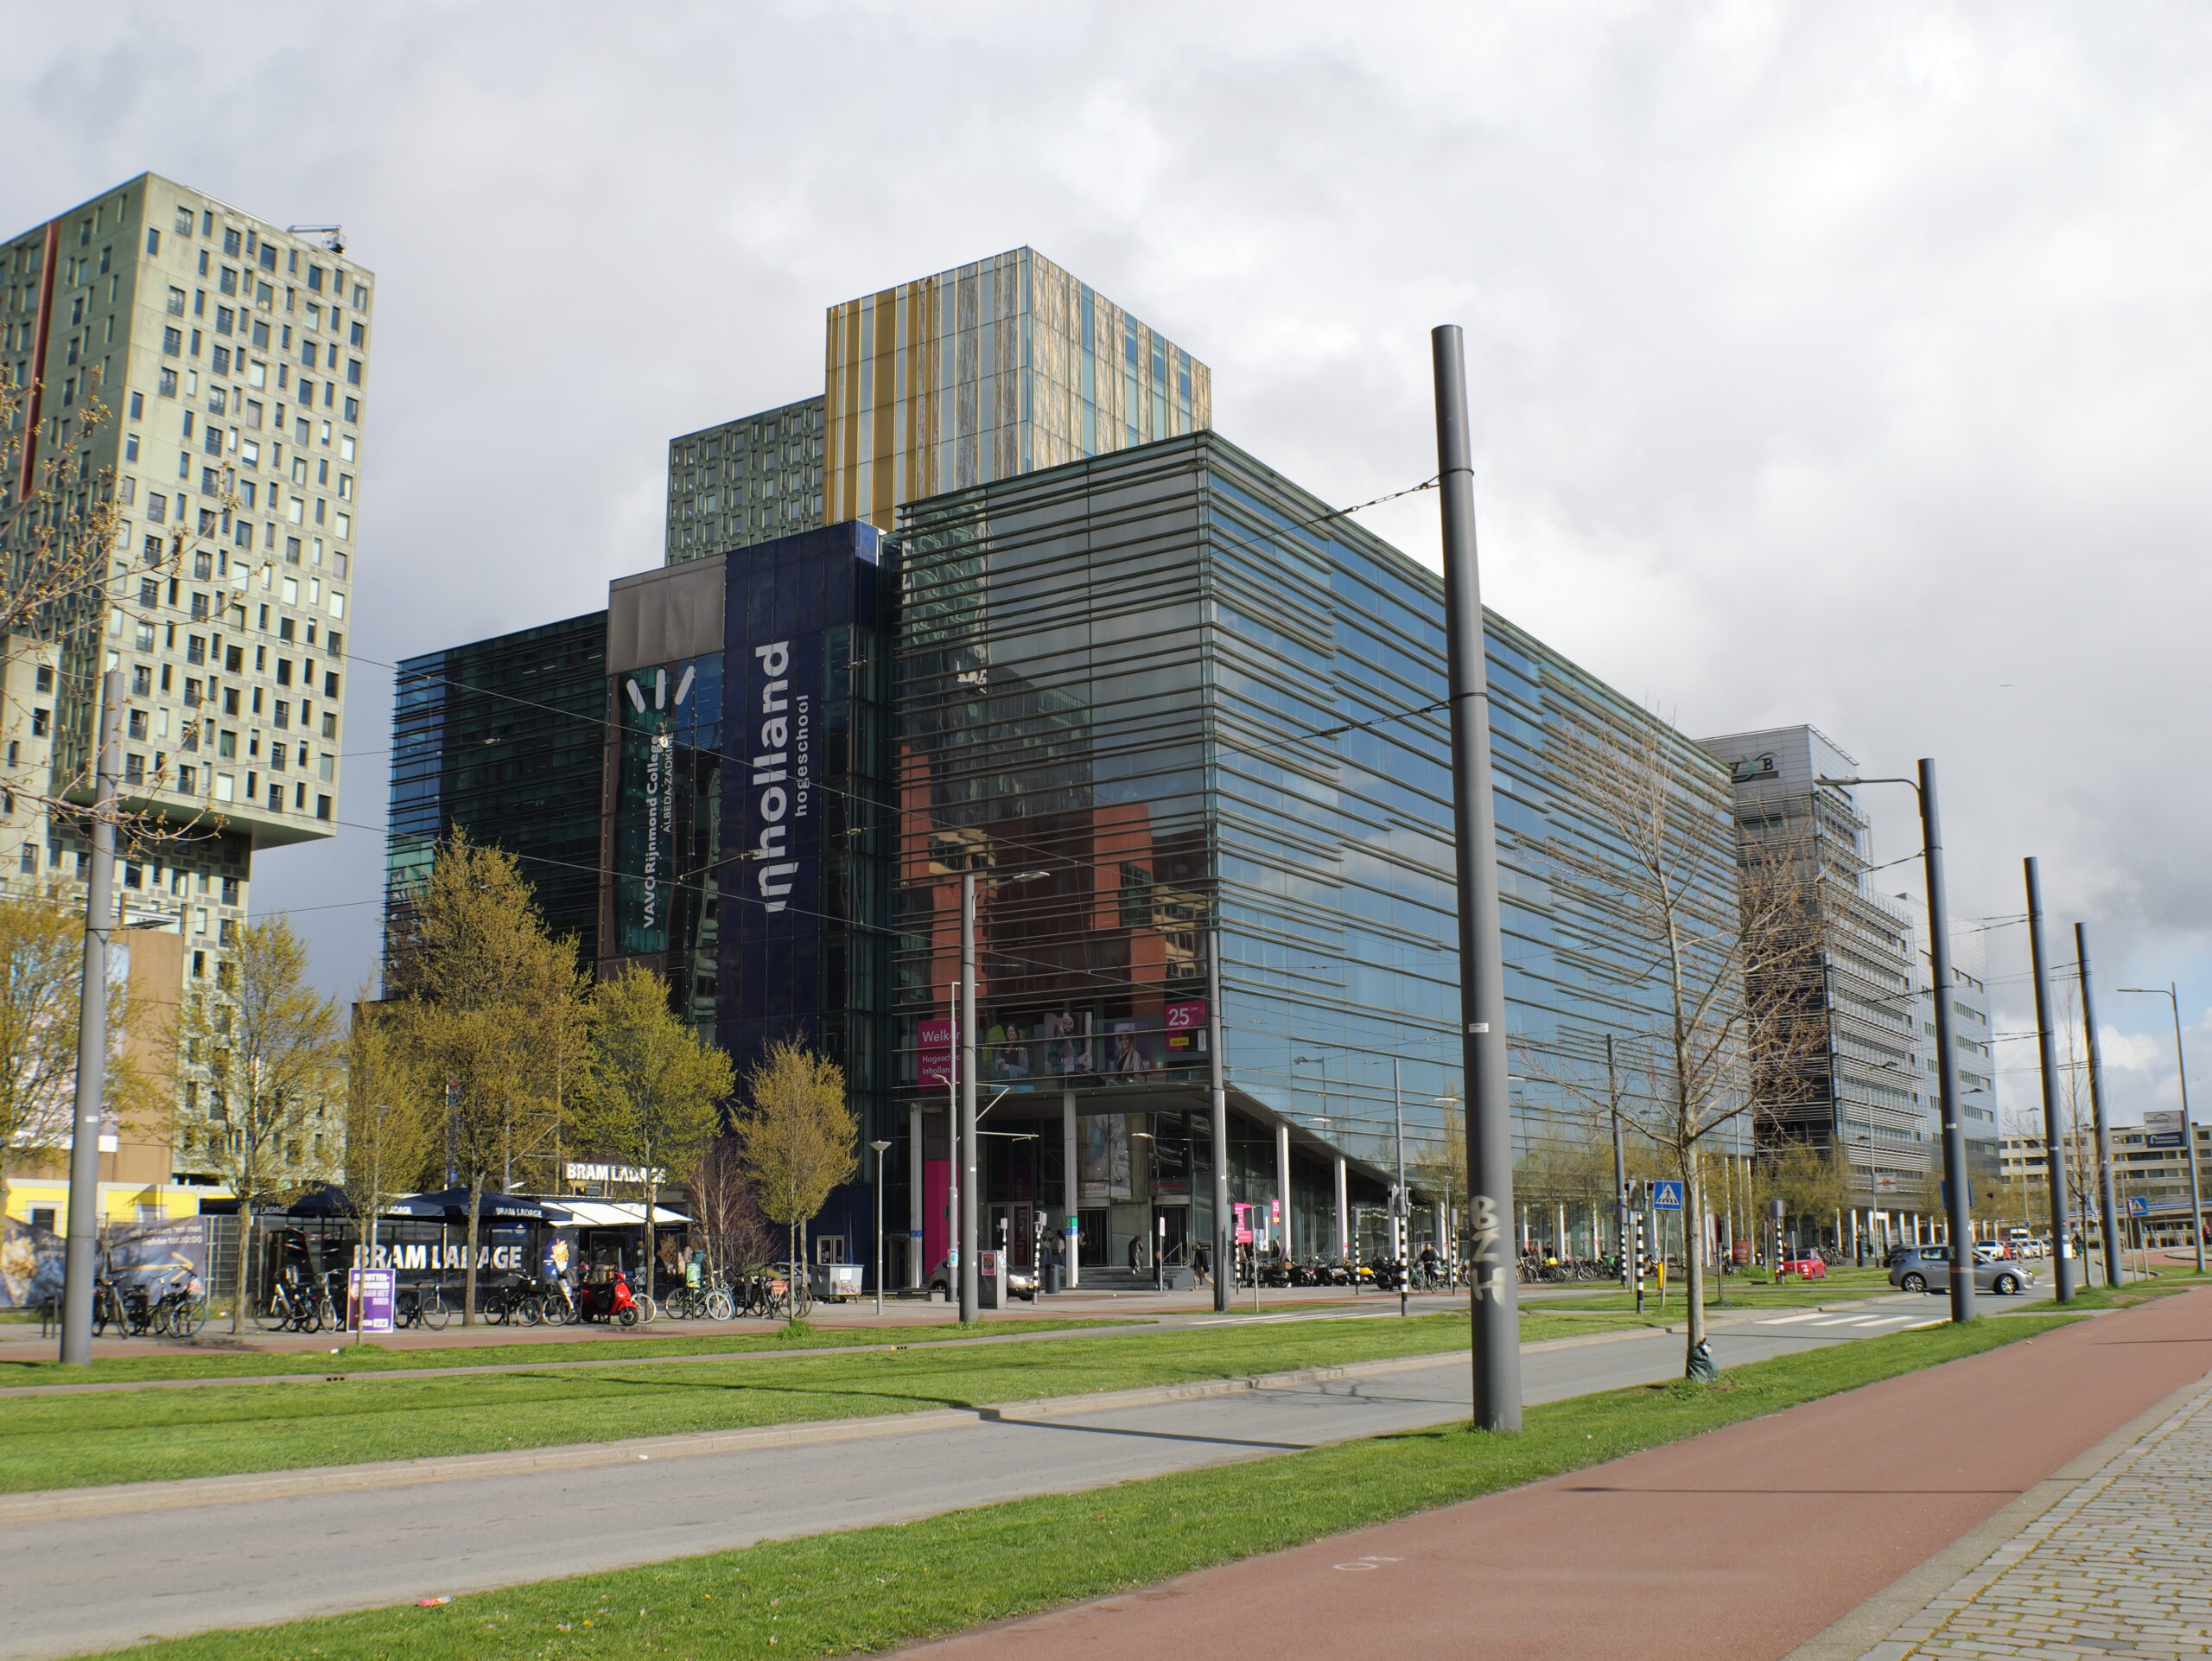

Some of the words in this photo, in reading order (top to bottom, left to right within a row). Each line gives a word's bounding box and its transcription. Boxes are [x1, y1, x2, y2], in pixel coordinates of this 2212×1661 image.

[646, 735, 664, 795] College
[794, 694, 809, 817] hogeschool
[645, 797, 660, 874] Rijnmond
[644, 875, 656, 929] VAVO
[1168, 1008, 1190, 1026] 25
[922, 1029, 961, 1042] Welk
[922, 1066, 950, 1075] Inhollan
[566, 1163, 609, 1181] BRAM
[496, 1206, 517, 1216] BRAM
[517, 1208, 543, 1218] LADAGE
[353, 1244, 427, 1270] BRAM
